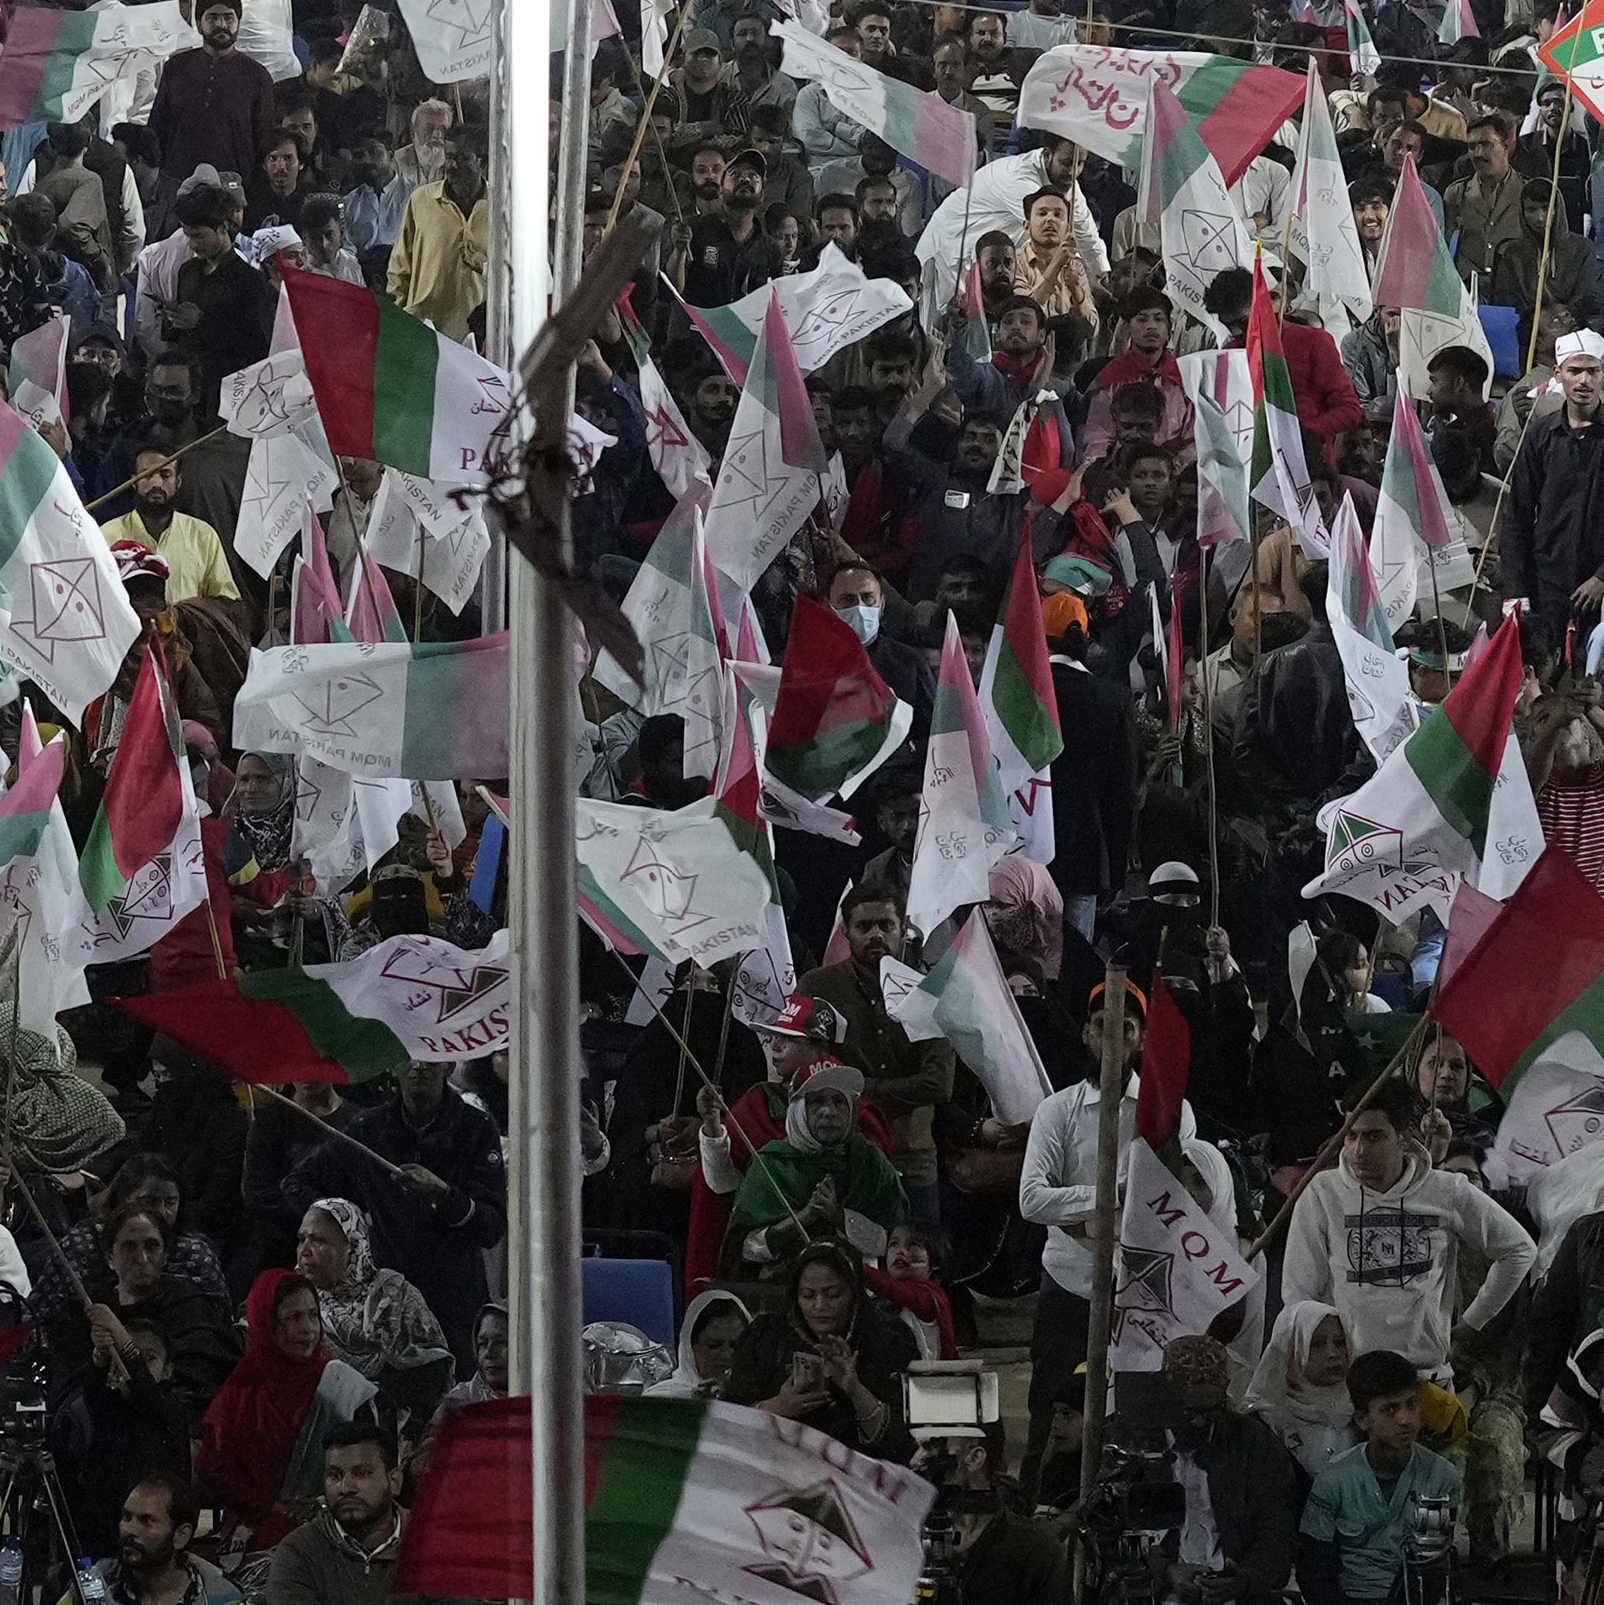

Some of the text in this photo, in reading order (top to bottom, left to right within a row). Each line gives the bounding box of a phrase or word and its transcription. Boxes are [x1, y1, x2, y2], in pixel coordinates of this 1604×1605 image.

[813, 303, 905, 366] MQM PAKISTAN
[693, 923, 760, 956] AKISTAN
[1145, 1189, 1246, 1299] MQM
